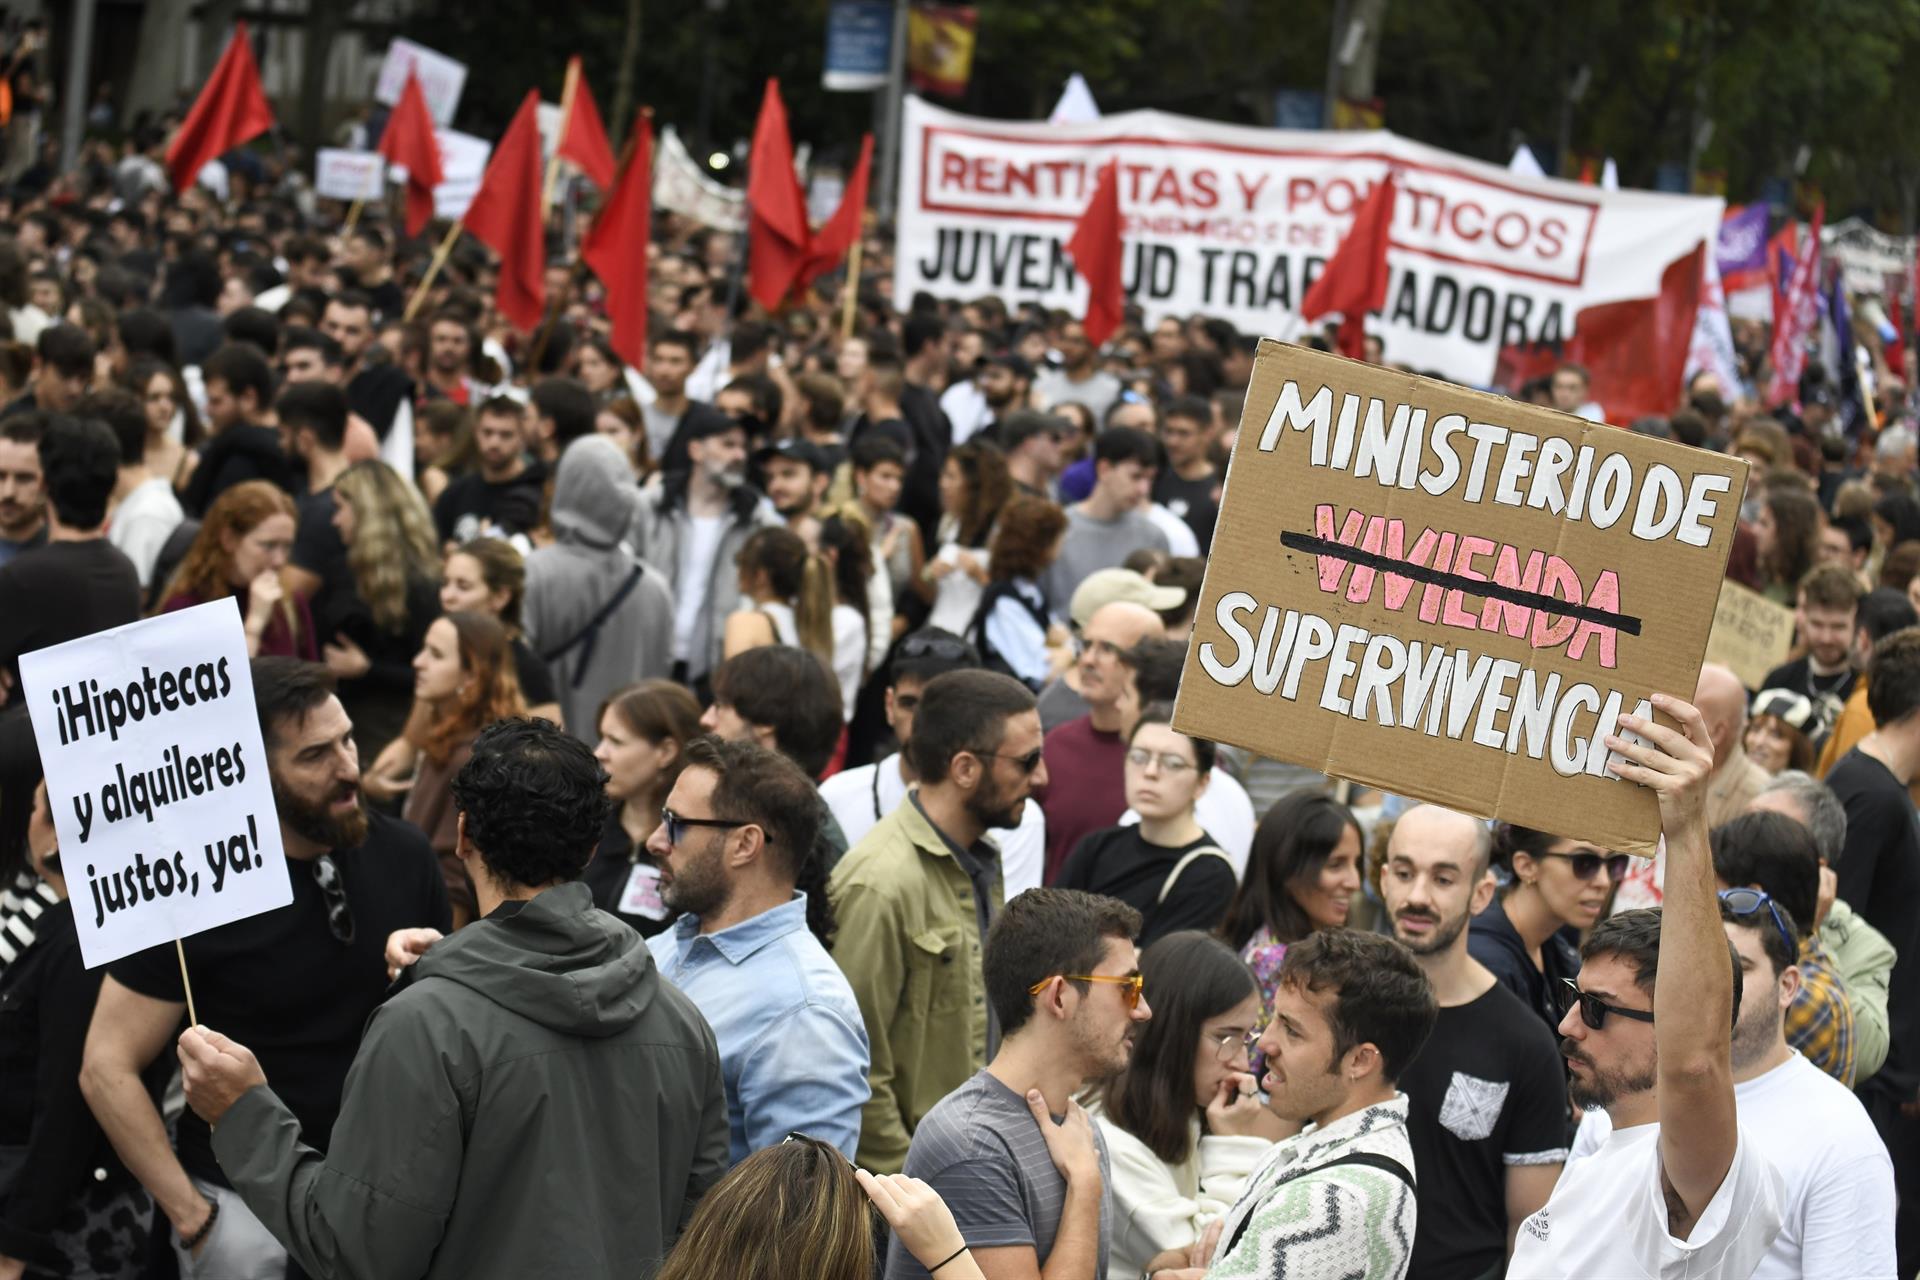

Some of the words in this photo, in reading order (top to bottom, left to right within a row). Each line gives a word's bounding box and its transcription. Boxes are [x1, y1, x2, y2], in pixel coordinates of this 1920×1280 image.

[1235, 169, 1271, 212] Y
[1287, 176, 1568, 259] POTICOS
[1289, 223, 1325, 247] DE
[919, 226, 1178, 300] JUVENUD
[1258, 380, 1632, 530] MINISTERIO
[1631, 462, 1731, 547] DE
[1314, 503, 1619, 669] VIVIENDA
[52, 656, 231, 746] ¡Hipotecas
[73, 791, 93, 844] y
[101, 742, 246, 823] alquileres
[87, 850, 200, 929] justos,
[204, 814, 263, 893] ya!
